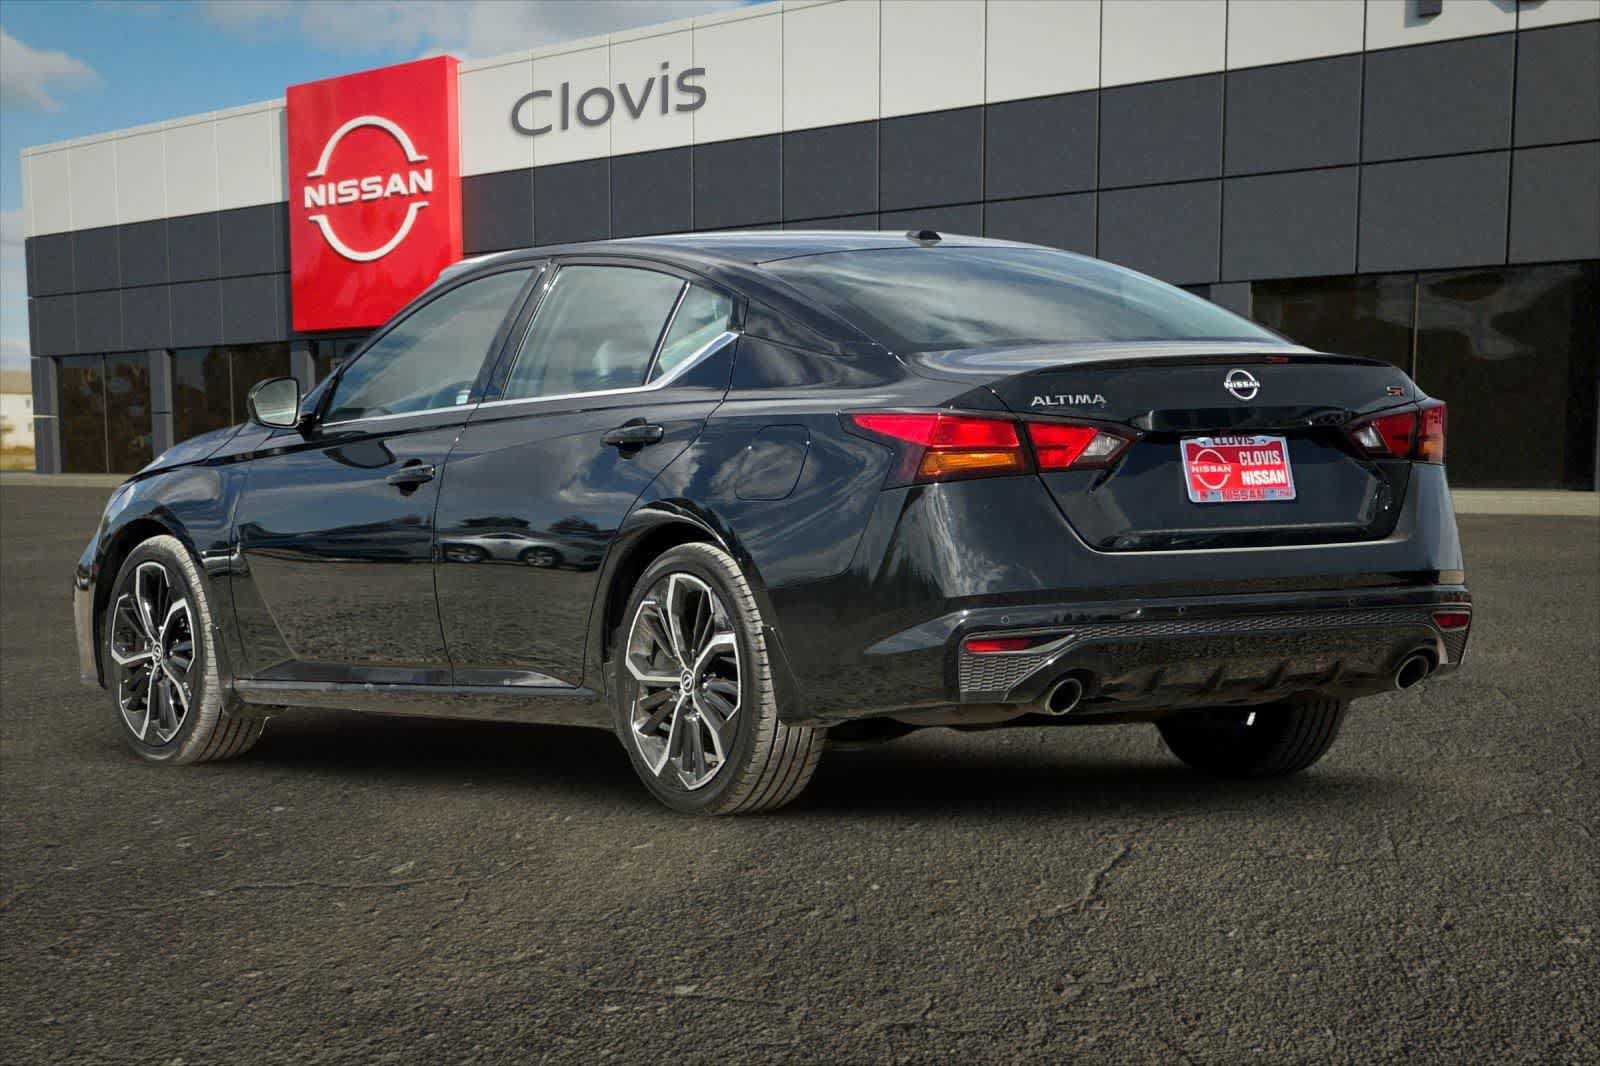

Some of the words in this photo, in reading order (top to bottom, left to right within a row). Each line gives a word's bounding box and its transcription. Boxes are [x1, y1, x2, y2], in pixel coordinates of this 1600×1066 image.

[511, 61, 706, 136] Clovis
[304, 168, 433, 208] NISSAN
[1224, 380, 1260, 389] NISSAN
[1031, 394, 1107, 407] ALTIMA
[1239, 450, 1281, 466] CLOVIS
[1191, 465, 1231, 473] NISSAN
[1241, 470, 1286, 486] NISSAN
